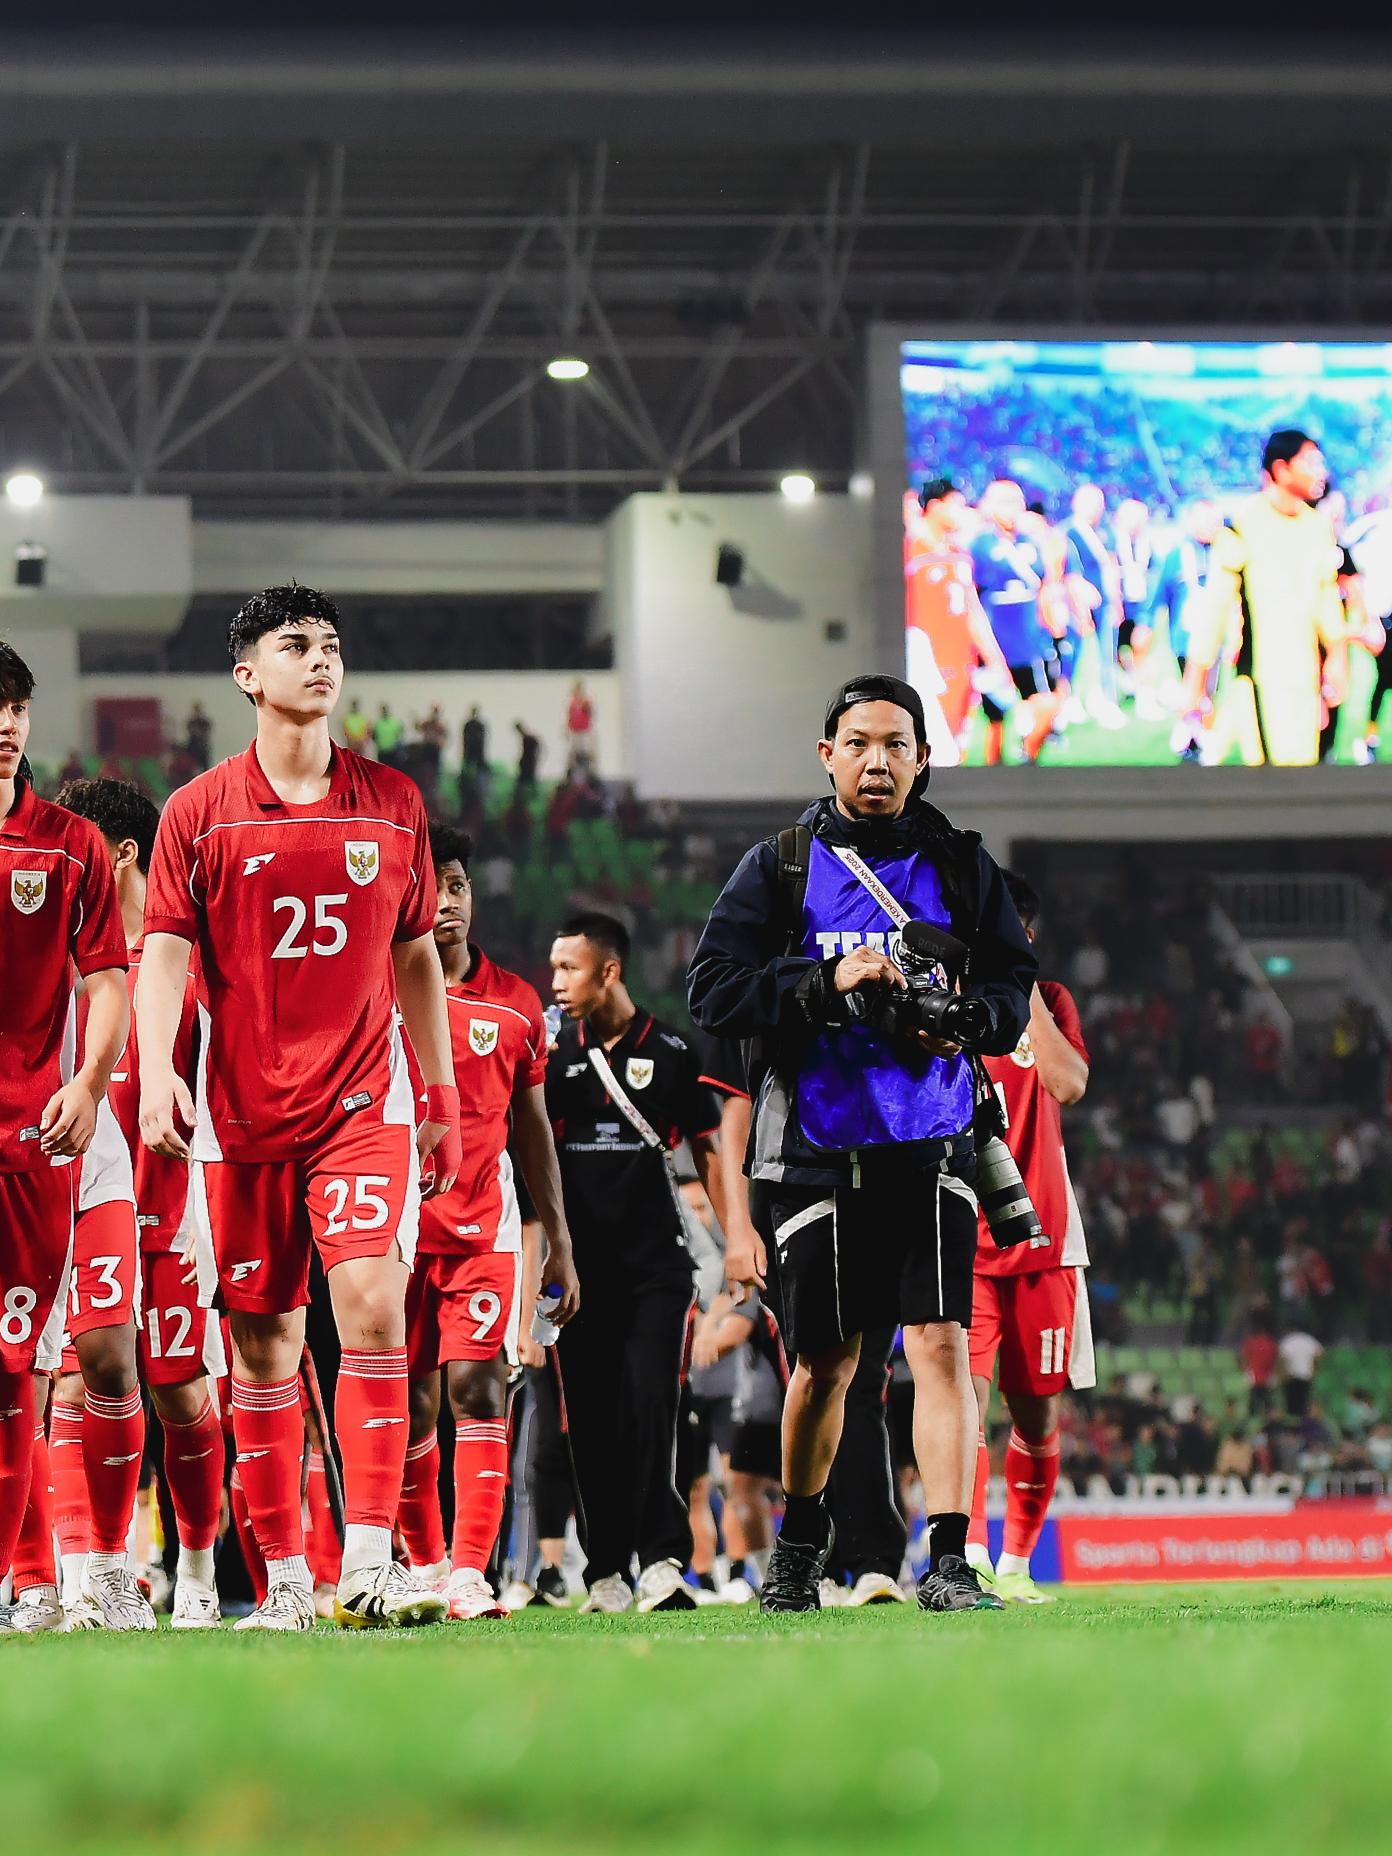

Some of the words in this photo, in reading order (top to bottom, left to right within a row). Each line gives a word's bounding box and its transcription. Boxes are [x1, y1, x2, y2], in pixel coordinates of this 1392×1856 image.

[844, 853, 862, 872] 2025
[859, 870, 901, 918] KEMERDEKAAN
[270, 892, 349, 959] 25
[321, 1175, 391, 1237] 25
[69, 1255, 124, 1317] 13
[0, 1285, 37, 1345] 8
[145, 1305, 196, 1359] 12
[467, 1290, 502, 1341] 9
[1039, 1326, 1066, 1375] 11
